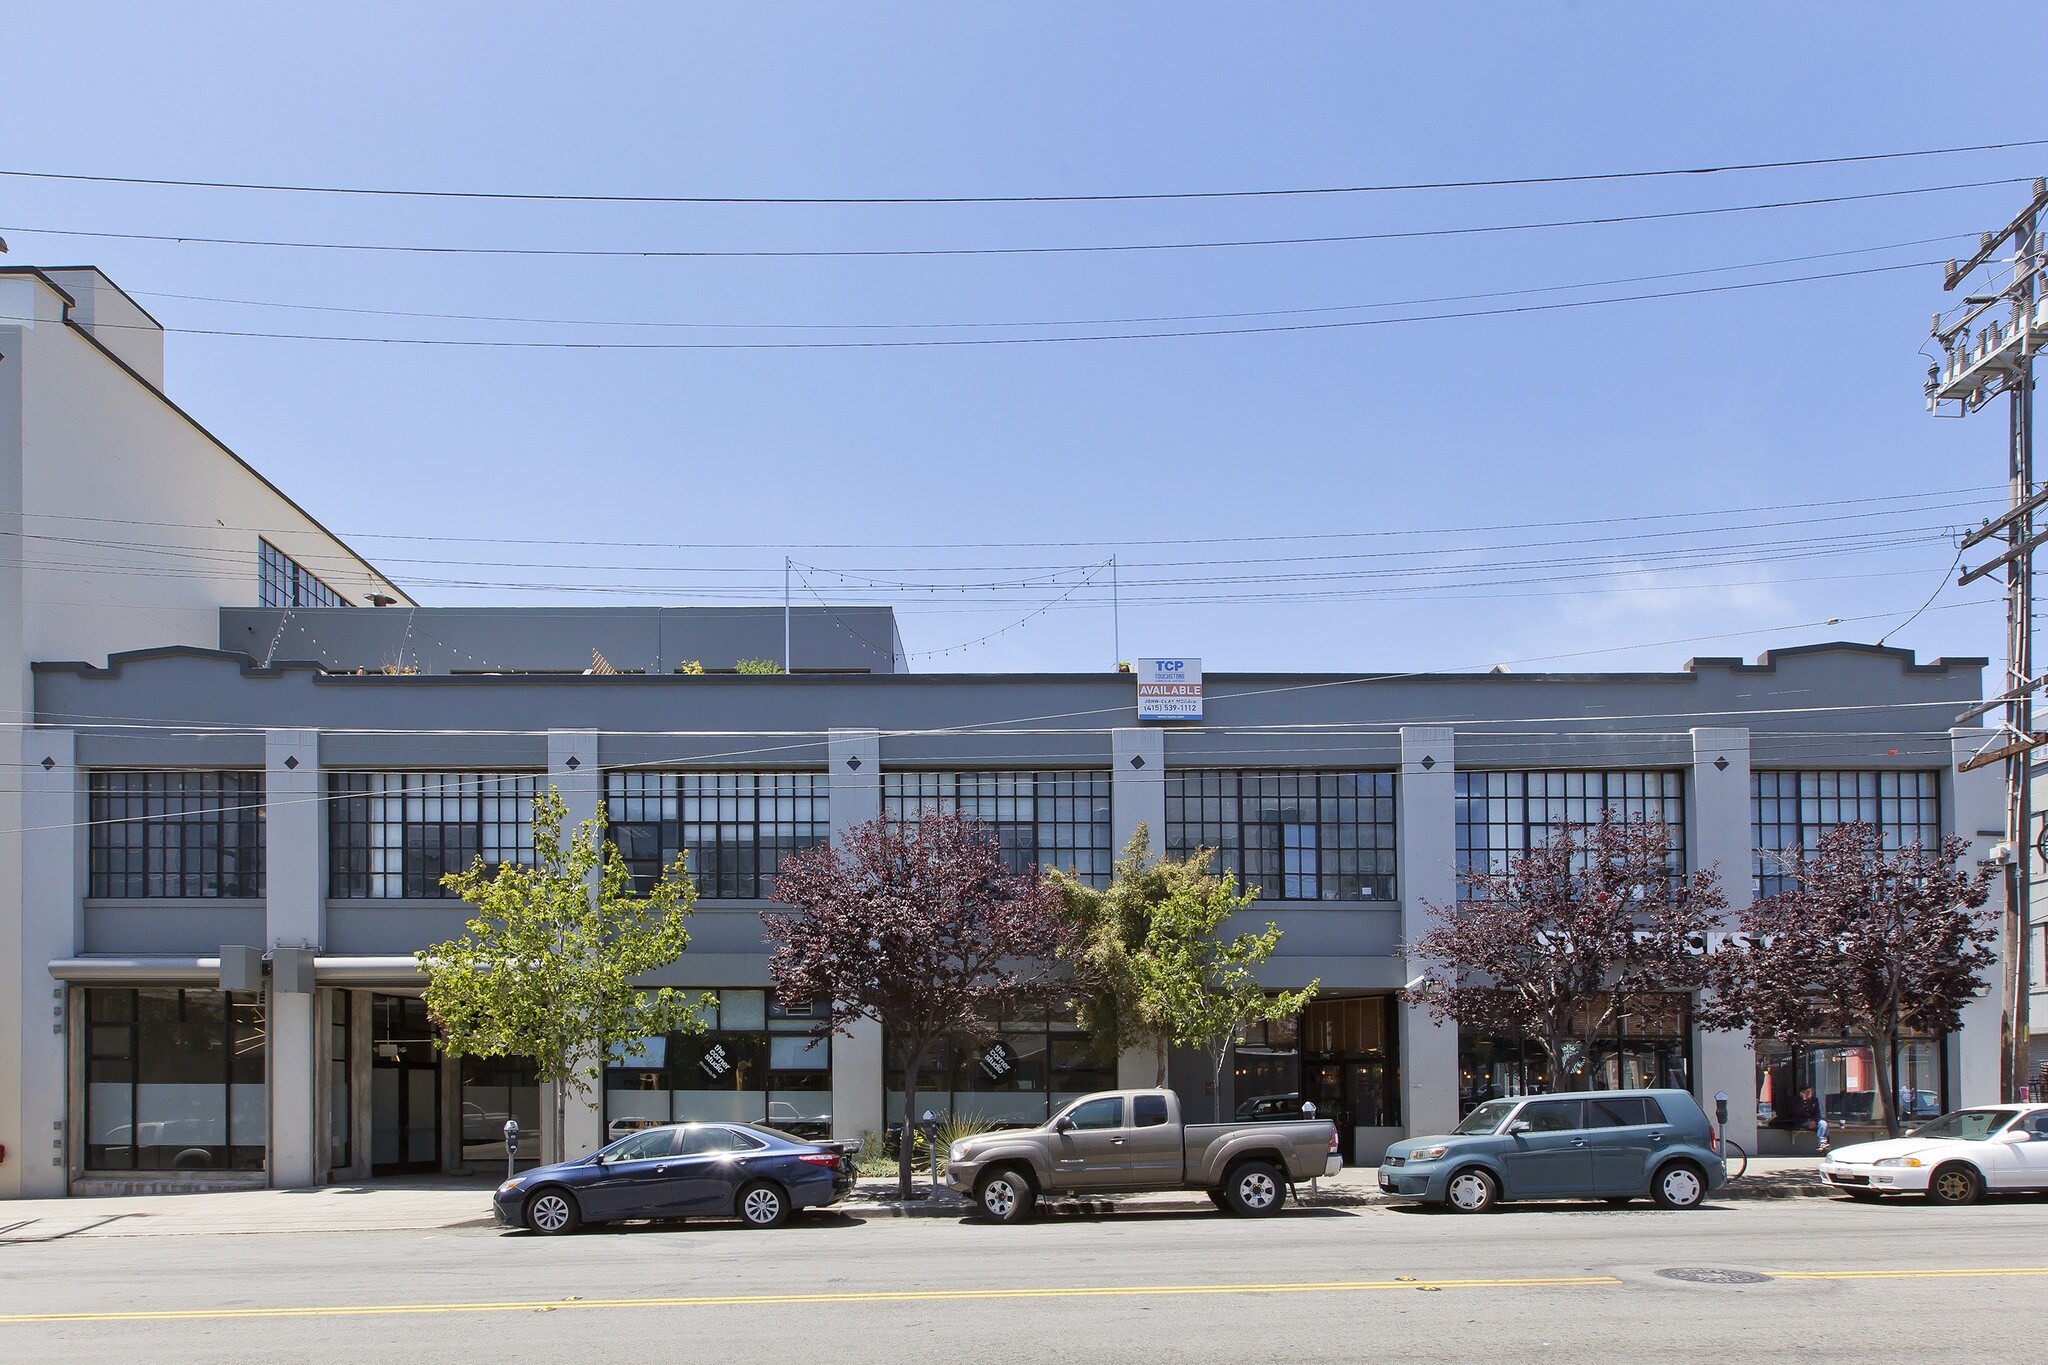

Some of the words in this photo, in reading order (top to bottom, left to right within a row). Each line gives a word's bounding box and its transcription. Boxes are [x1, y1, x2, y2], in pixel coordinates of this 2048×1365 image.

[1155, 661, 1184, 671] TCP
[1140, 686, 1201, 695] AVAILABLE
[1144, 704, 1163, 712] (415)
[1164, 704, 1197, 712] 539-1112
[1536, 931, 1751, 955] STBCKS
[714, 1044, 726, 1057] the
[994, 1045, 1006, 1057] the
[704, 1054, 724, 1074] studio
[709, 1049, 731, 1070] corner
[984, 1054, 1004, 1074] studio
[989, 1050, 1011, 1070] corner
